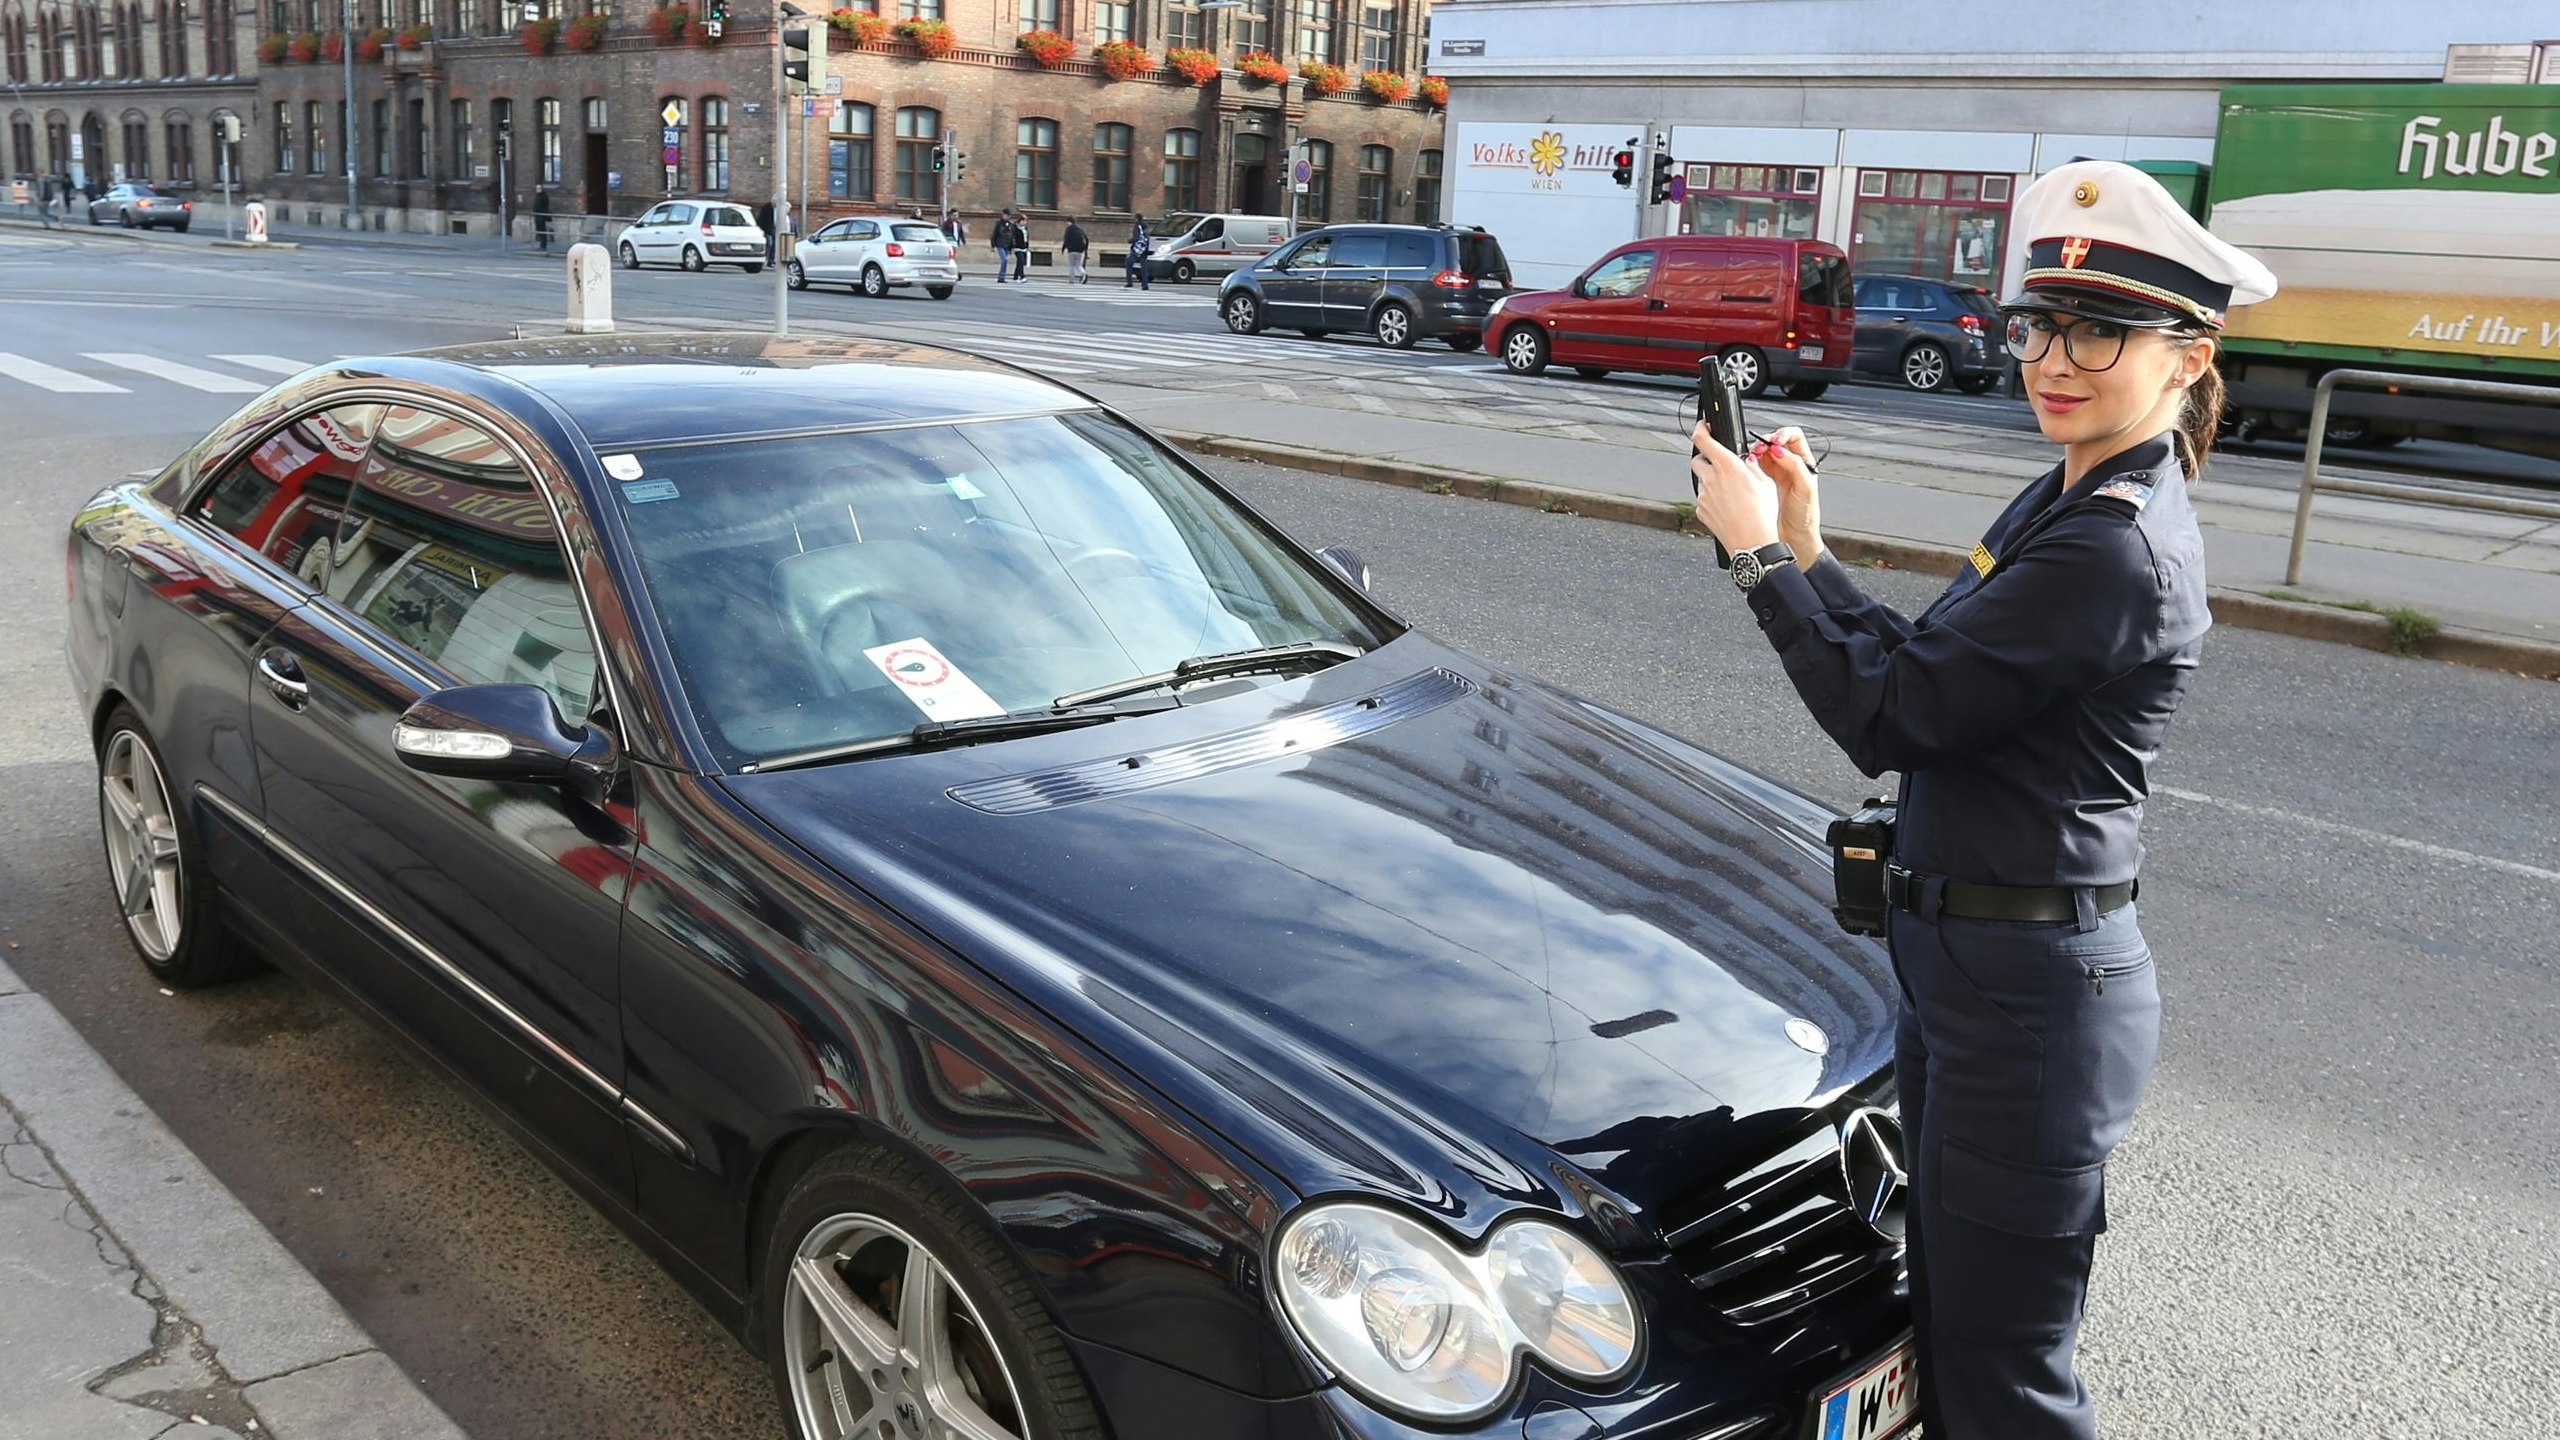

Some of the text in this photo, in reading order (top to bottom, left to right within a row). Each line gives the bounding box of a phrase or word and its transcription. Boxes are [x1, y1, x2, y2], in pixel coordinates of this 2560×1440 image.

[664, 131, 679, 143] 230
[1473, 143, 1616, 166] Volks hilf
[1531, 179, 1562, 190] WIEN
[2408, 314, 2475, 341] Auf
[2476, 316, 2529, 345] Ihr
[1858, 1373, 1888, 1440] W
